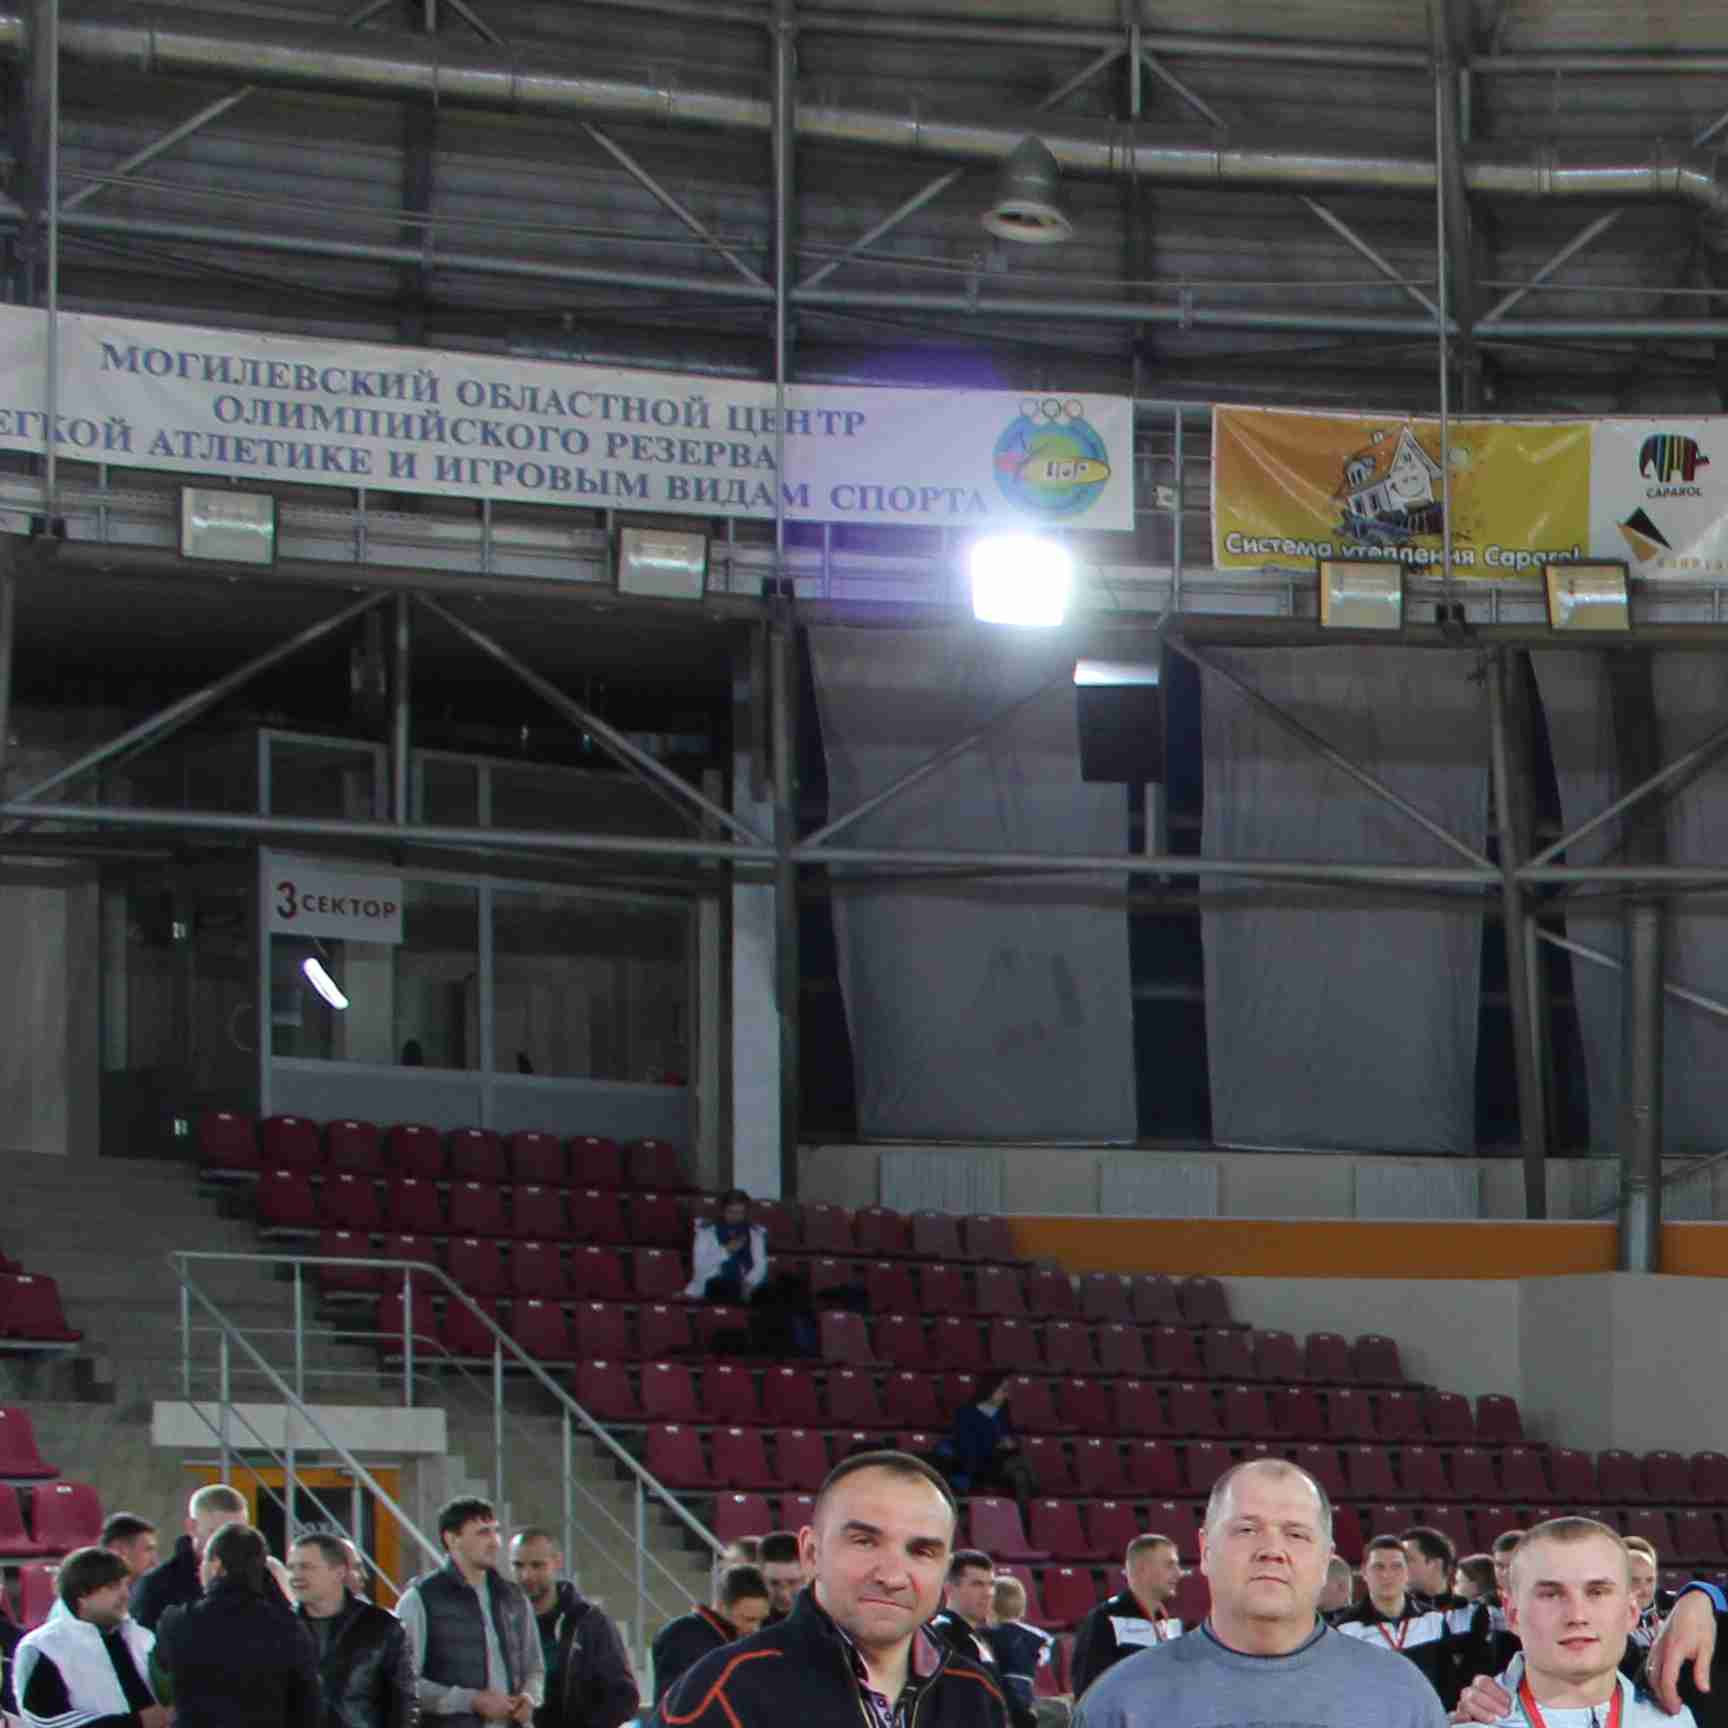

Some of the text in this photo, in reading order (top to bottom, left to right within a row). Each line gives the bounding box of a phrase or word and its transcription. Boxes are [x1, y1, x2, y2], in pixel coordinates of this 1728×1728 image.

[100, 341, 866, 438] МОГИЛЕВСКИЙ ОБЛАСТНОЙ ЦЕНТР
[148, 429, 373, 475] АТЛЕТИКЕ
[388, 450, 417, 480] И
[434, 454, 650, 499] ИГРОВЫМ
[665, 475, 810, 508] ВИДАМ
[830, 483, 989, 513] СПОРТА
[212, 395, 778, 471] ОЛИМПИЙСКОГО РЕЗЕРВА
[1224, 531, 1333, 560] Система
[276, 880, 399, 920] 3 СЕКТОР
